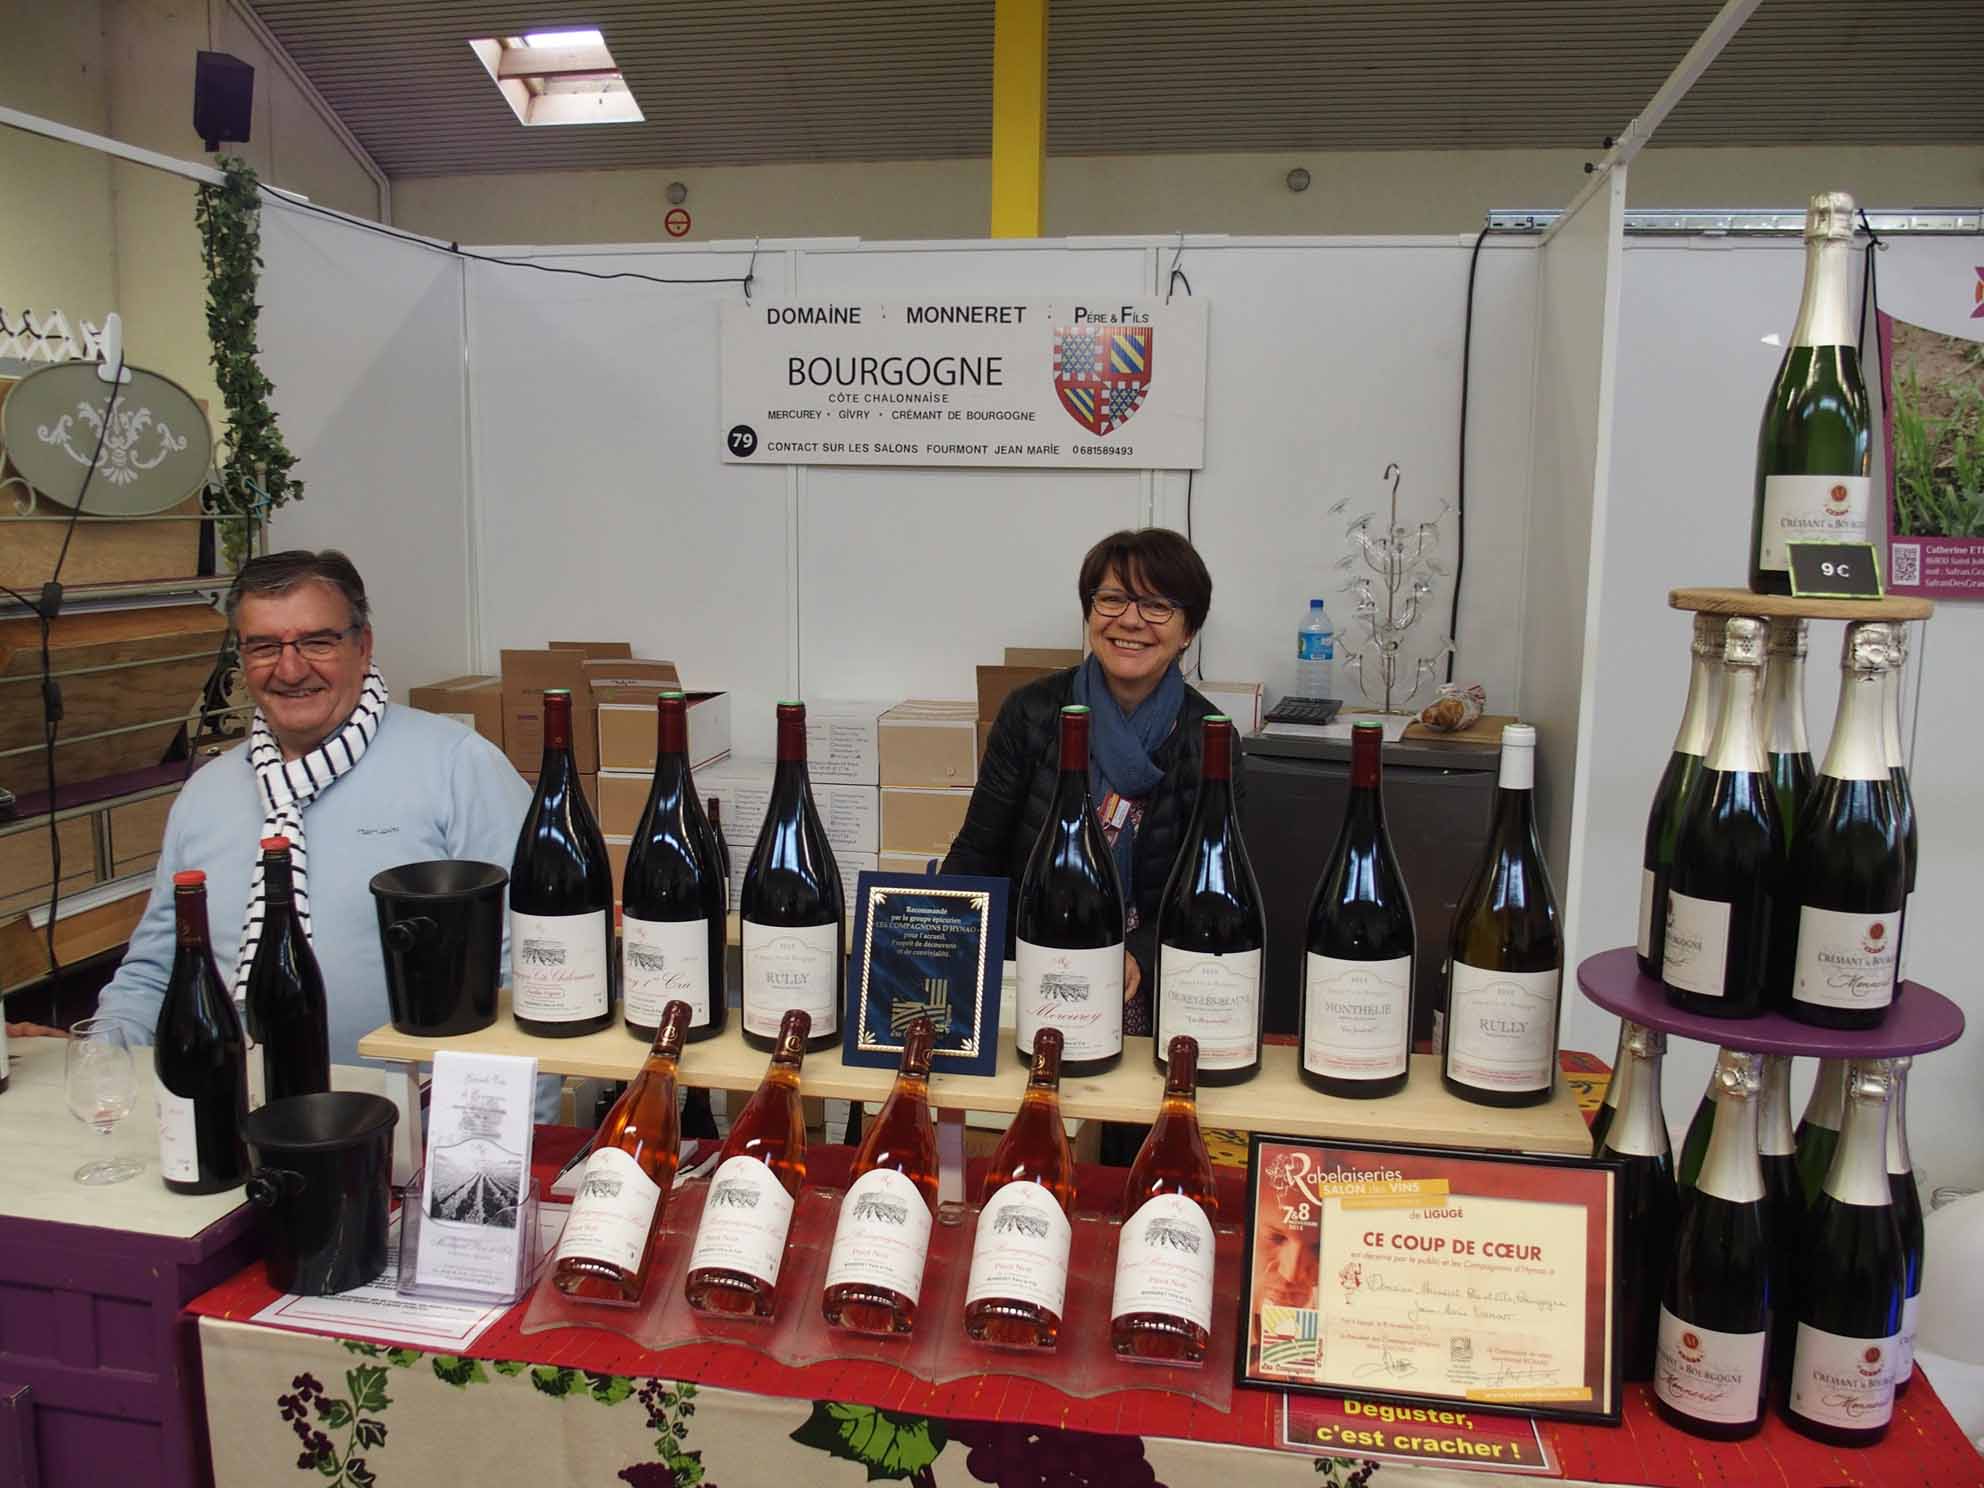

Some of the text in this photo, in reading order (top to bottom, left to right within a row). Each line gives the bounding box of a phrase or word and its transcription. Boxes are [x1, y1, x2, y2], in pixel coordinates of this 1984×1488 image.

[906, 305, 1027, 324] MONNERET
[1109, 314, 1118, 324] &
[788, 356, 1003, 387] BOURGOGNE
[767, 409, 823, 420] MERCUREY
[947, 410, 962, 421] DE
[966, 410, 1036, 422] BOURGOGNE
[731, 432, 754, 449] 79
[767, 442, 819, 453] CONTACT
[822, 443, 845, 453] SUR
[848, 443, 870, 454] LES
[873, 443, 919, 454] SALONS
[926, 444, 988, 455] FOURMONT
[993, 444, 1024, 456] JEAN
[889, 921, 941, 931] COMPAGNONS
[1479, 1018, 1529, 1033] RULLY
[1323, 1183, 1365, 1195] SALON
[1390, 1183, 1421, 1195] VINS
[1362, 1231, 1385, 1249] CE
[1391, 1233, 1446, 1253] COUP
[1452, 1239, 1476, 1255] DE
[1316, 1424, 1522, 1460] c'est cracher !
